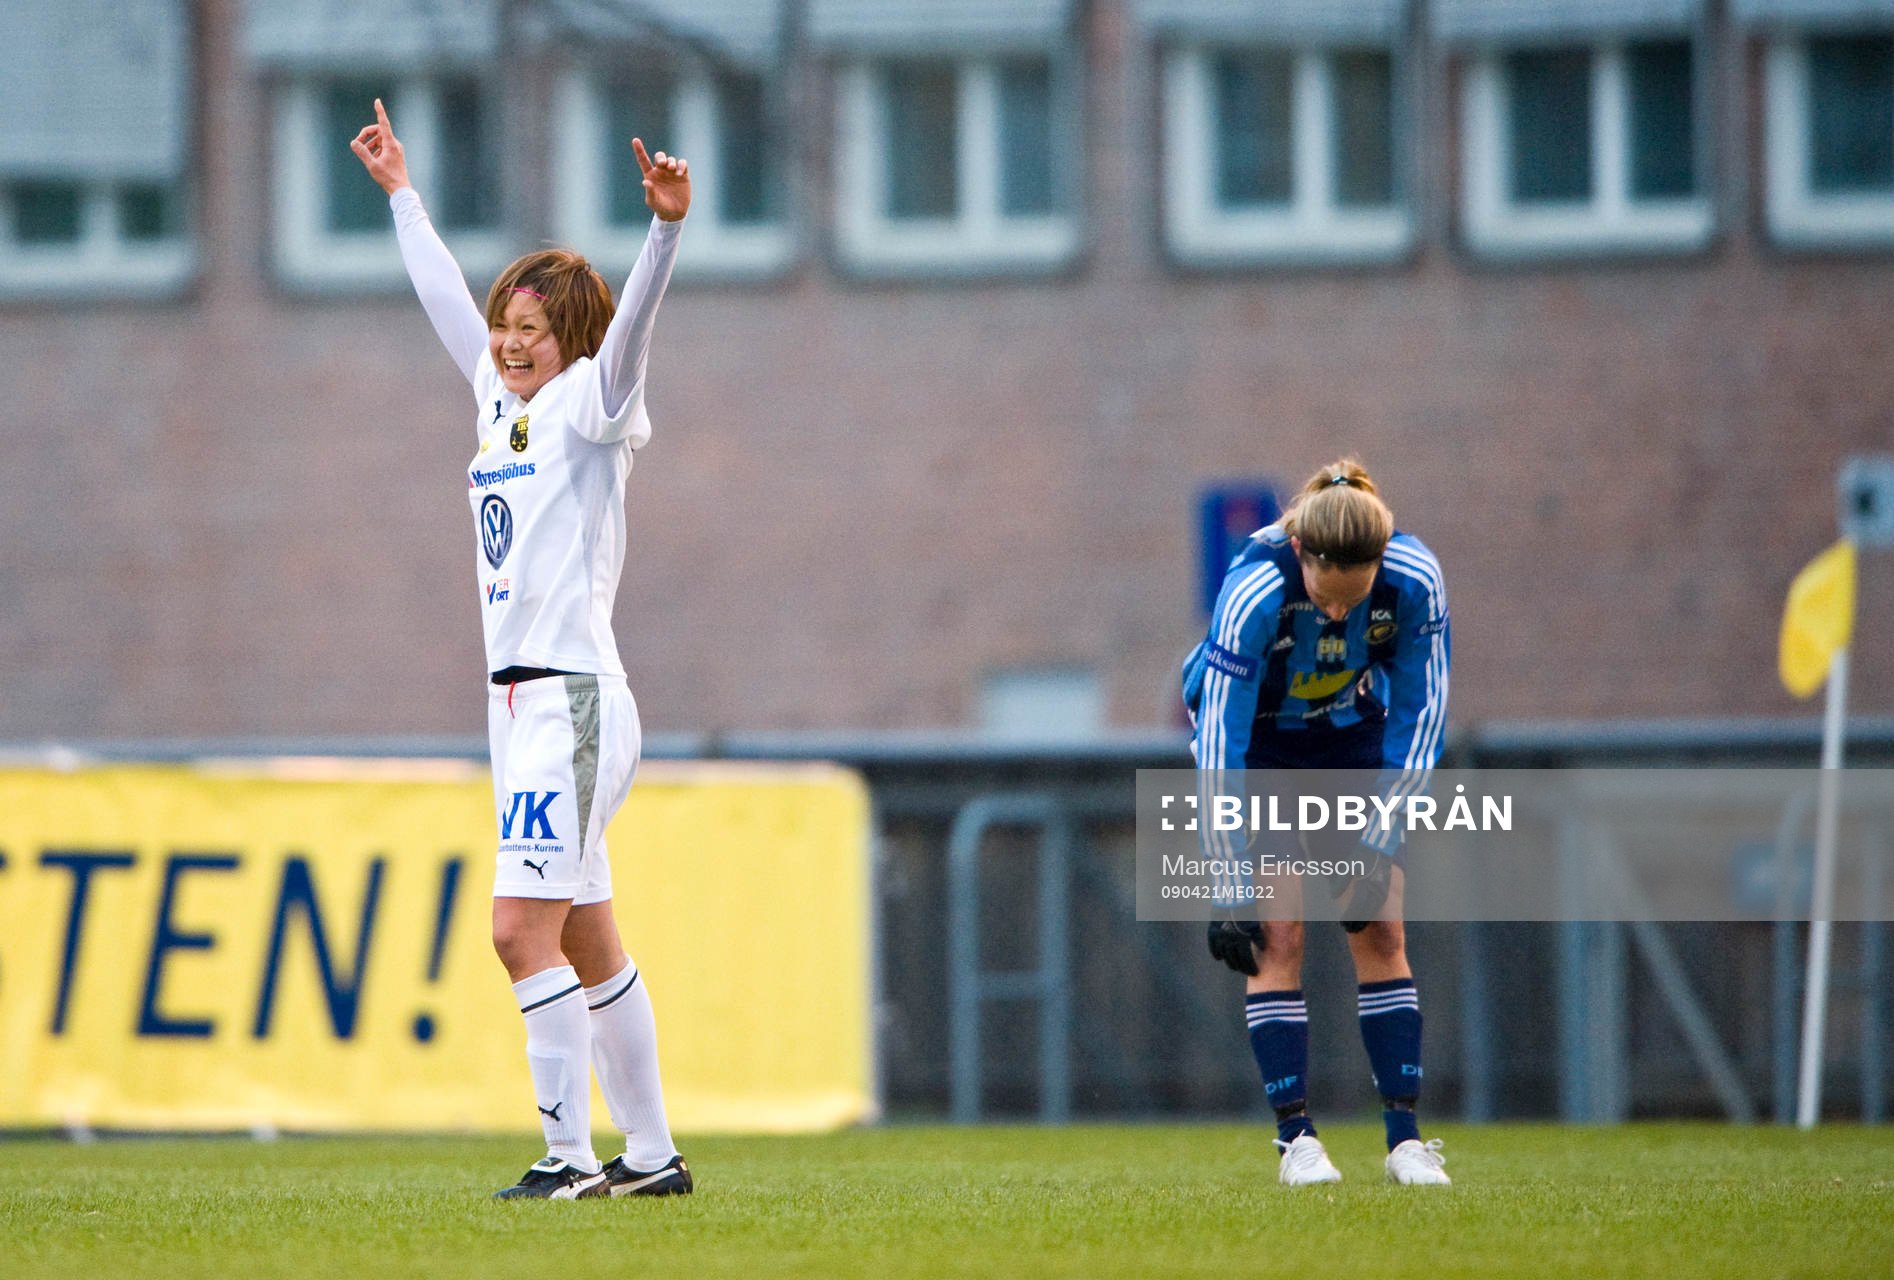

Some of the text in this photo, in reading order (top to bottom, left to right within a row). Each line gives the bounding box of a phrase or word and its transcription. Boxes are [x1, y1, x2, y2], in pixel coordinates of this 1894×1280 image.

[472, 463, 536, 490] Myresjöhus
[1371, 610, 1393, 620] ICA
[1206, 649, 1249, 677] olksam
[0, 850, 466, 1043] TEN!
[1265, 1075, 1297, 1095] DIF
